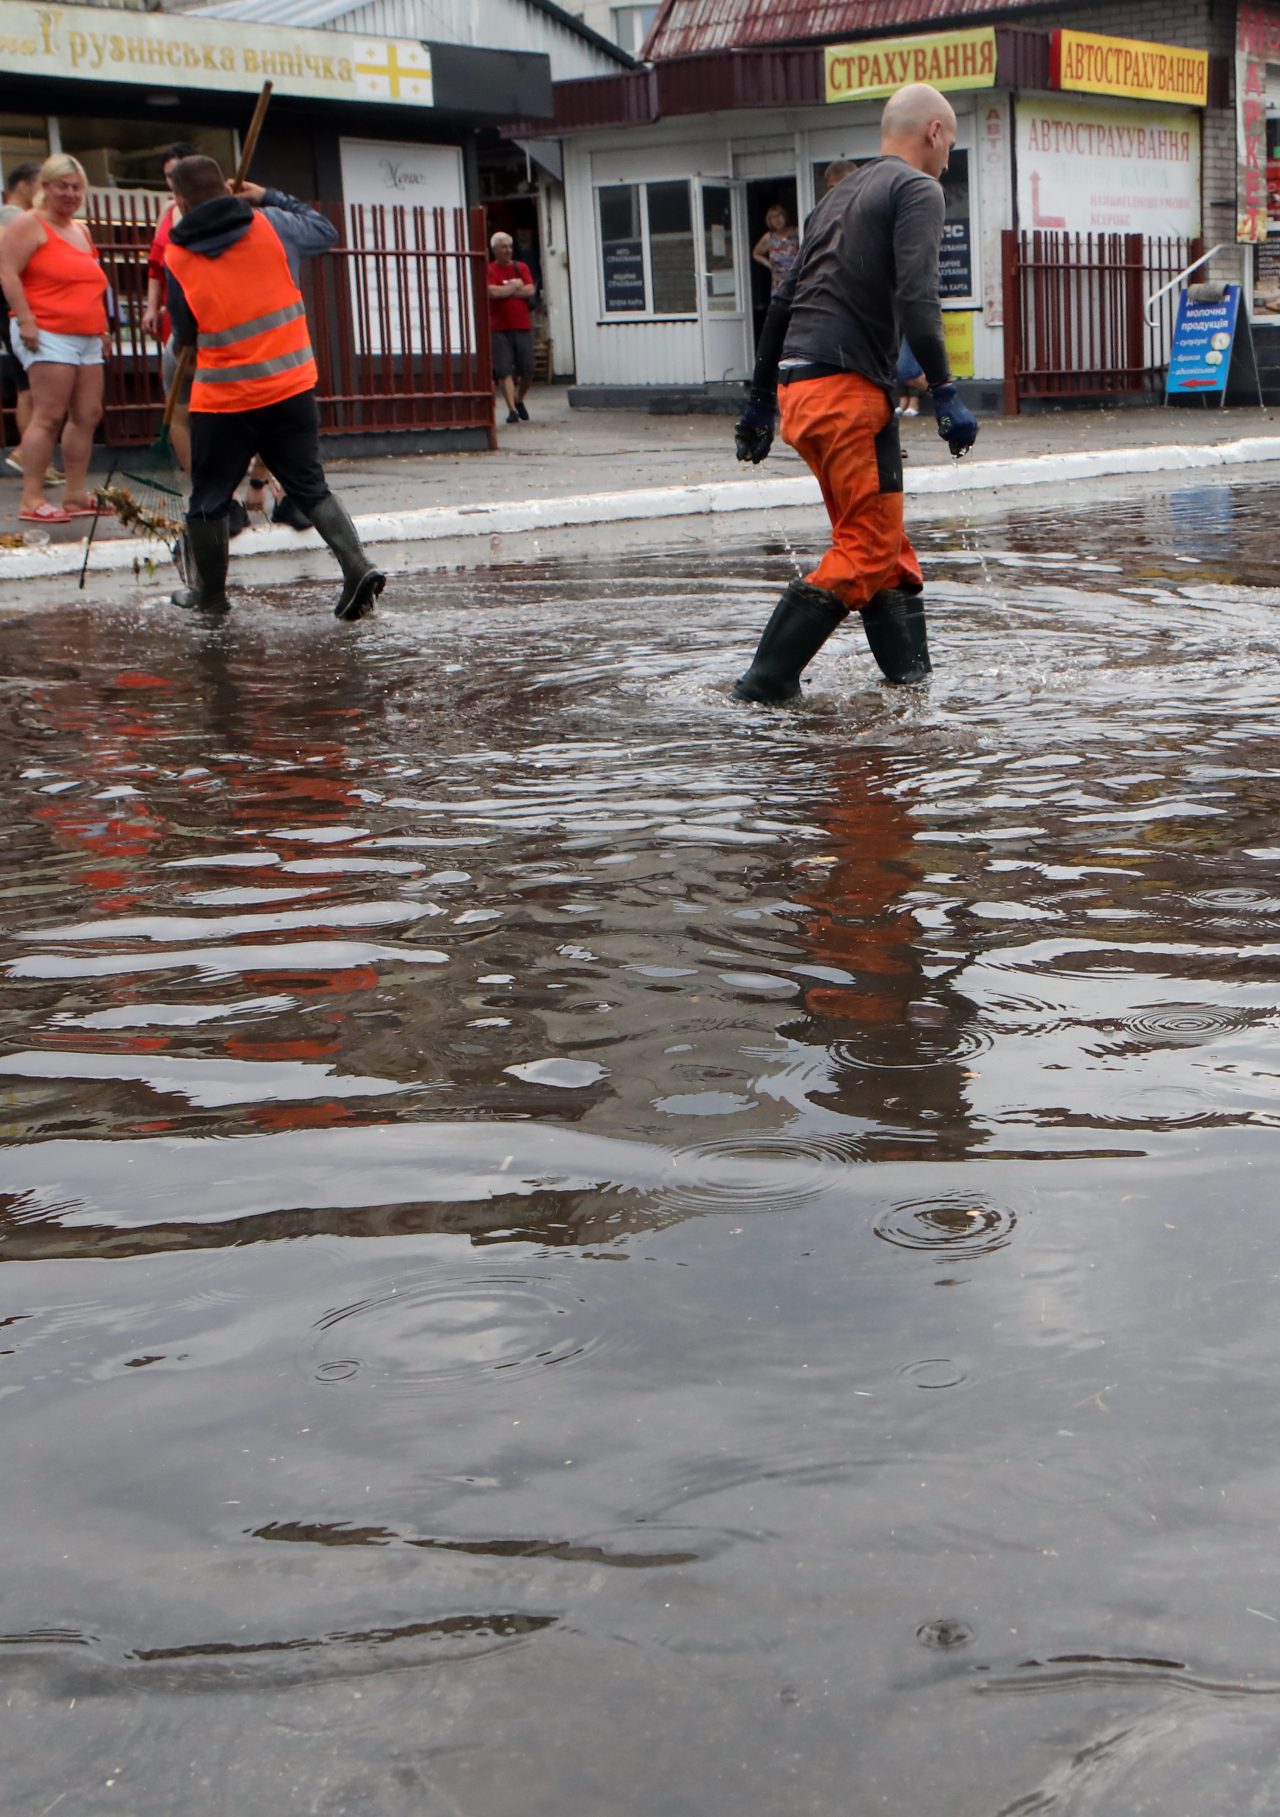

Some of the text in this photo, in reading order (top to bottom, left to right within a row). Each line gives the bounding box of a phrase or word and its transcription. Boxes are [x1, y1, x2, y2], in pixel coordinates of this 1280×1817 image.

[243, 47, 354, 82] випічка
[829, 40, 994, 90] СТРАХУВАННЯ
[1064, 42, 1205, 96] АВТОСТРАХУВАННЯ
[1029, 118, 1190, 161] АВТОСТРАХУВАННЯ
[1090, 212, 1131, 226] КСЕРОКС
[1181, 318, 1229, 333] продукція
[1186, 307, 1227, 318] молочна
